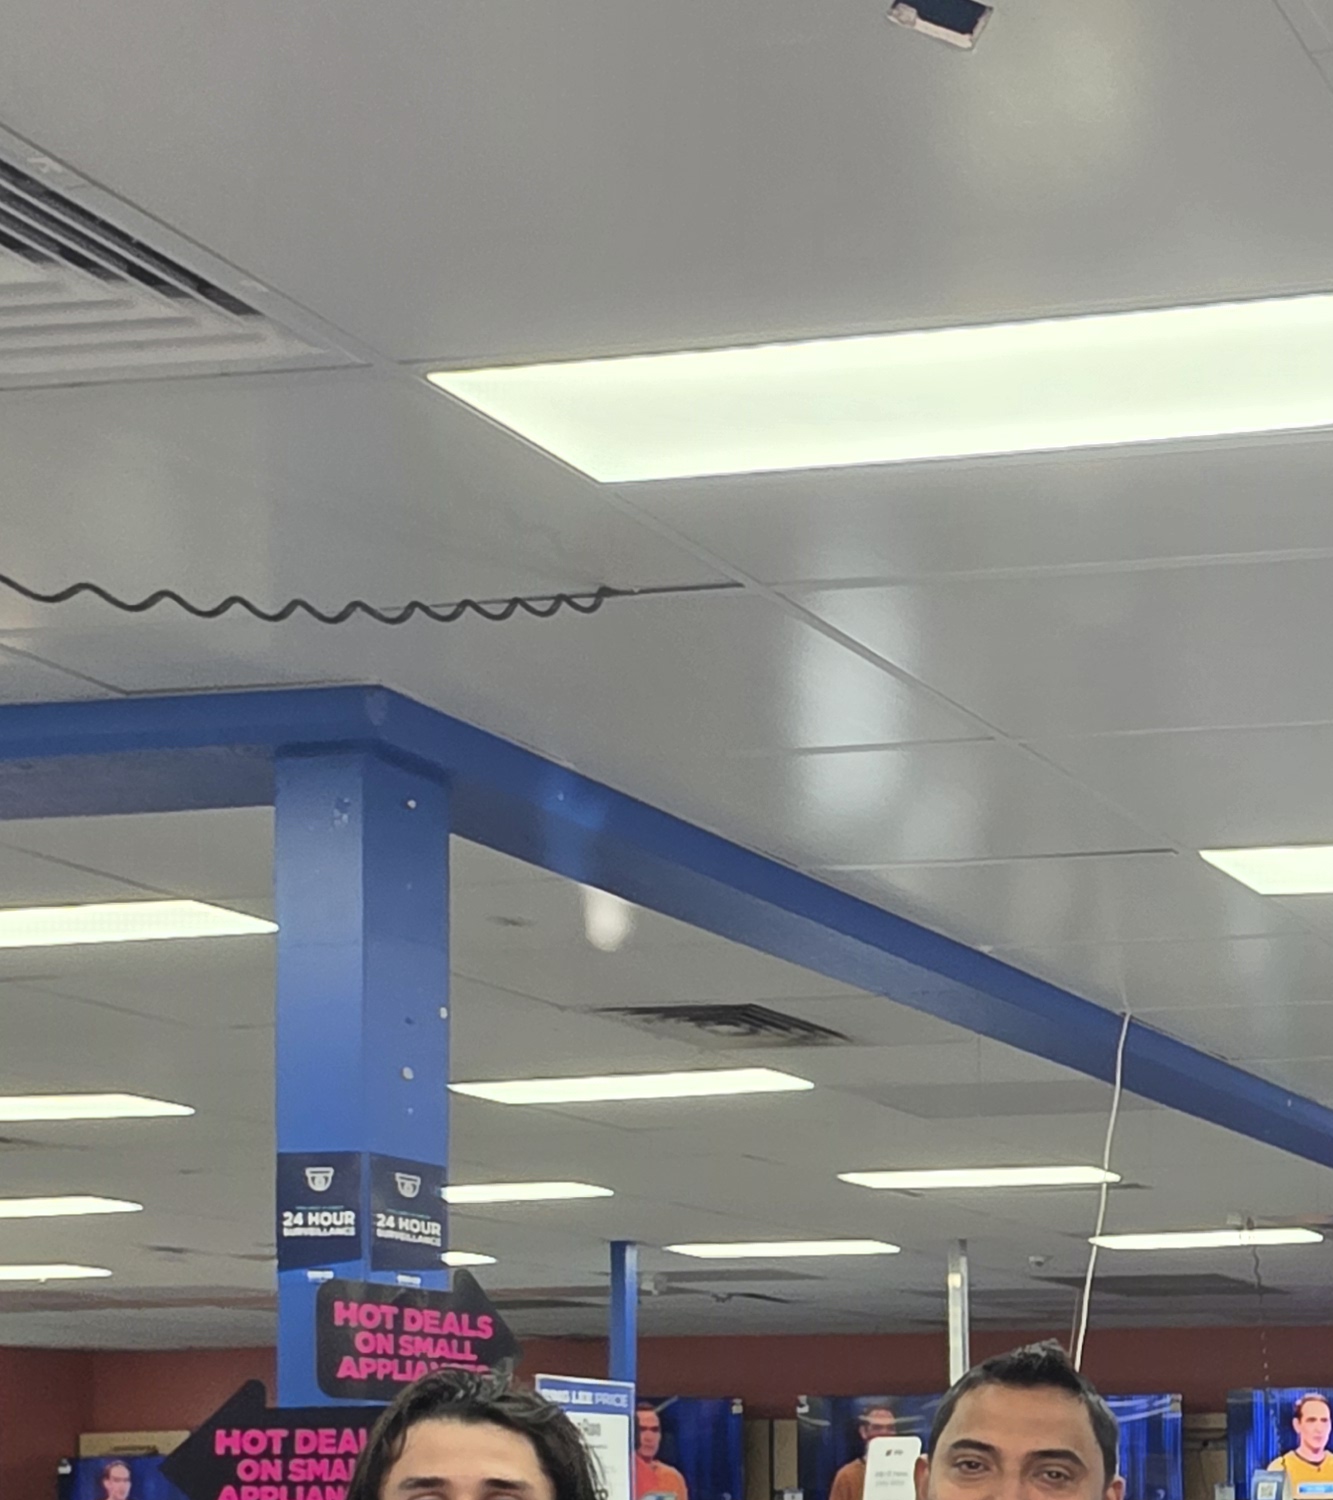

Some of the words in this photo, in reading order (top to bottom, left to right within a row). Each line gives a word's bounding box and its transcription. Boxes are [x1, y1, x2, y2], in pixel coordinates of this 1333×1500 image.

[282, 1211, 303, 1226] 24
[308, 1211, 356, 1226] HOUR
[376, 1214, 395, 1228] 24
[399, 1219, 441, 1236] HOUR
[334, 1300, 399, 1330] HOT
[403, 1308, 493, 1339] DEALS
[354, 1331, 394, 1354] ON
[398, 1334, 478, 1361] SMALL
[336, 1356, 494, 1382] APPLIA
[215, 1428, 289, 1455] HOT
[294, 1428, 367, 1455] DEAL
[237, 1458, 282, 1482] ON
[288, 1458, 356, 1482] SMAL
